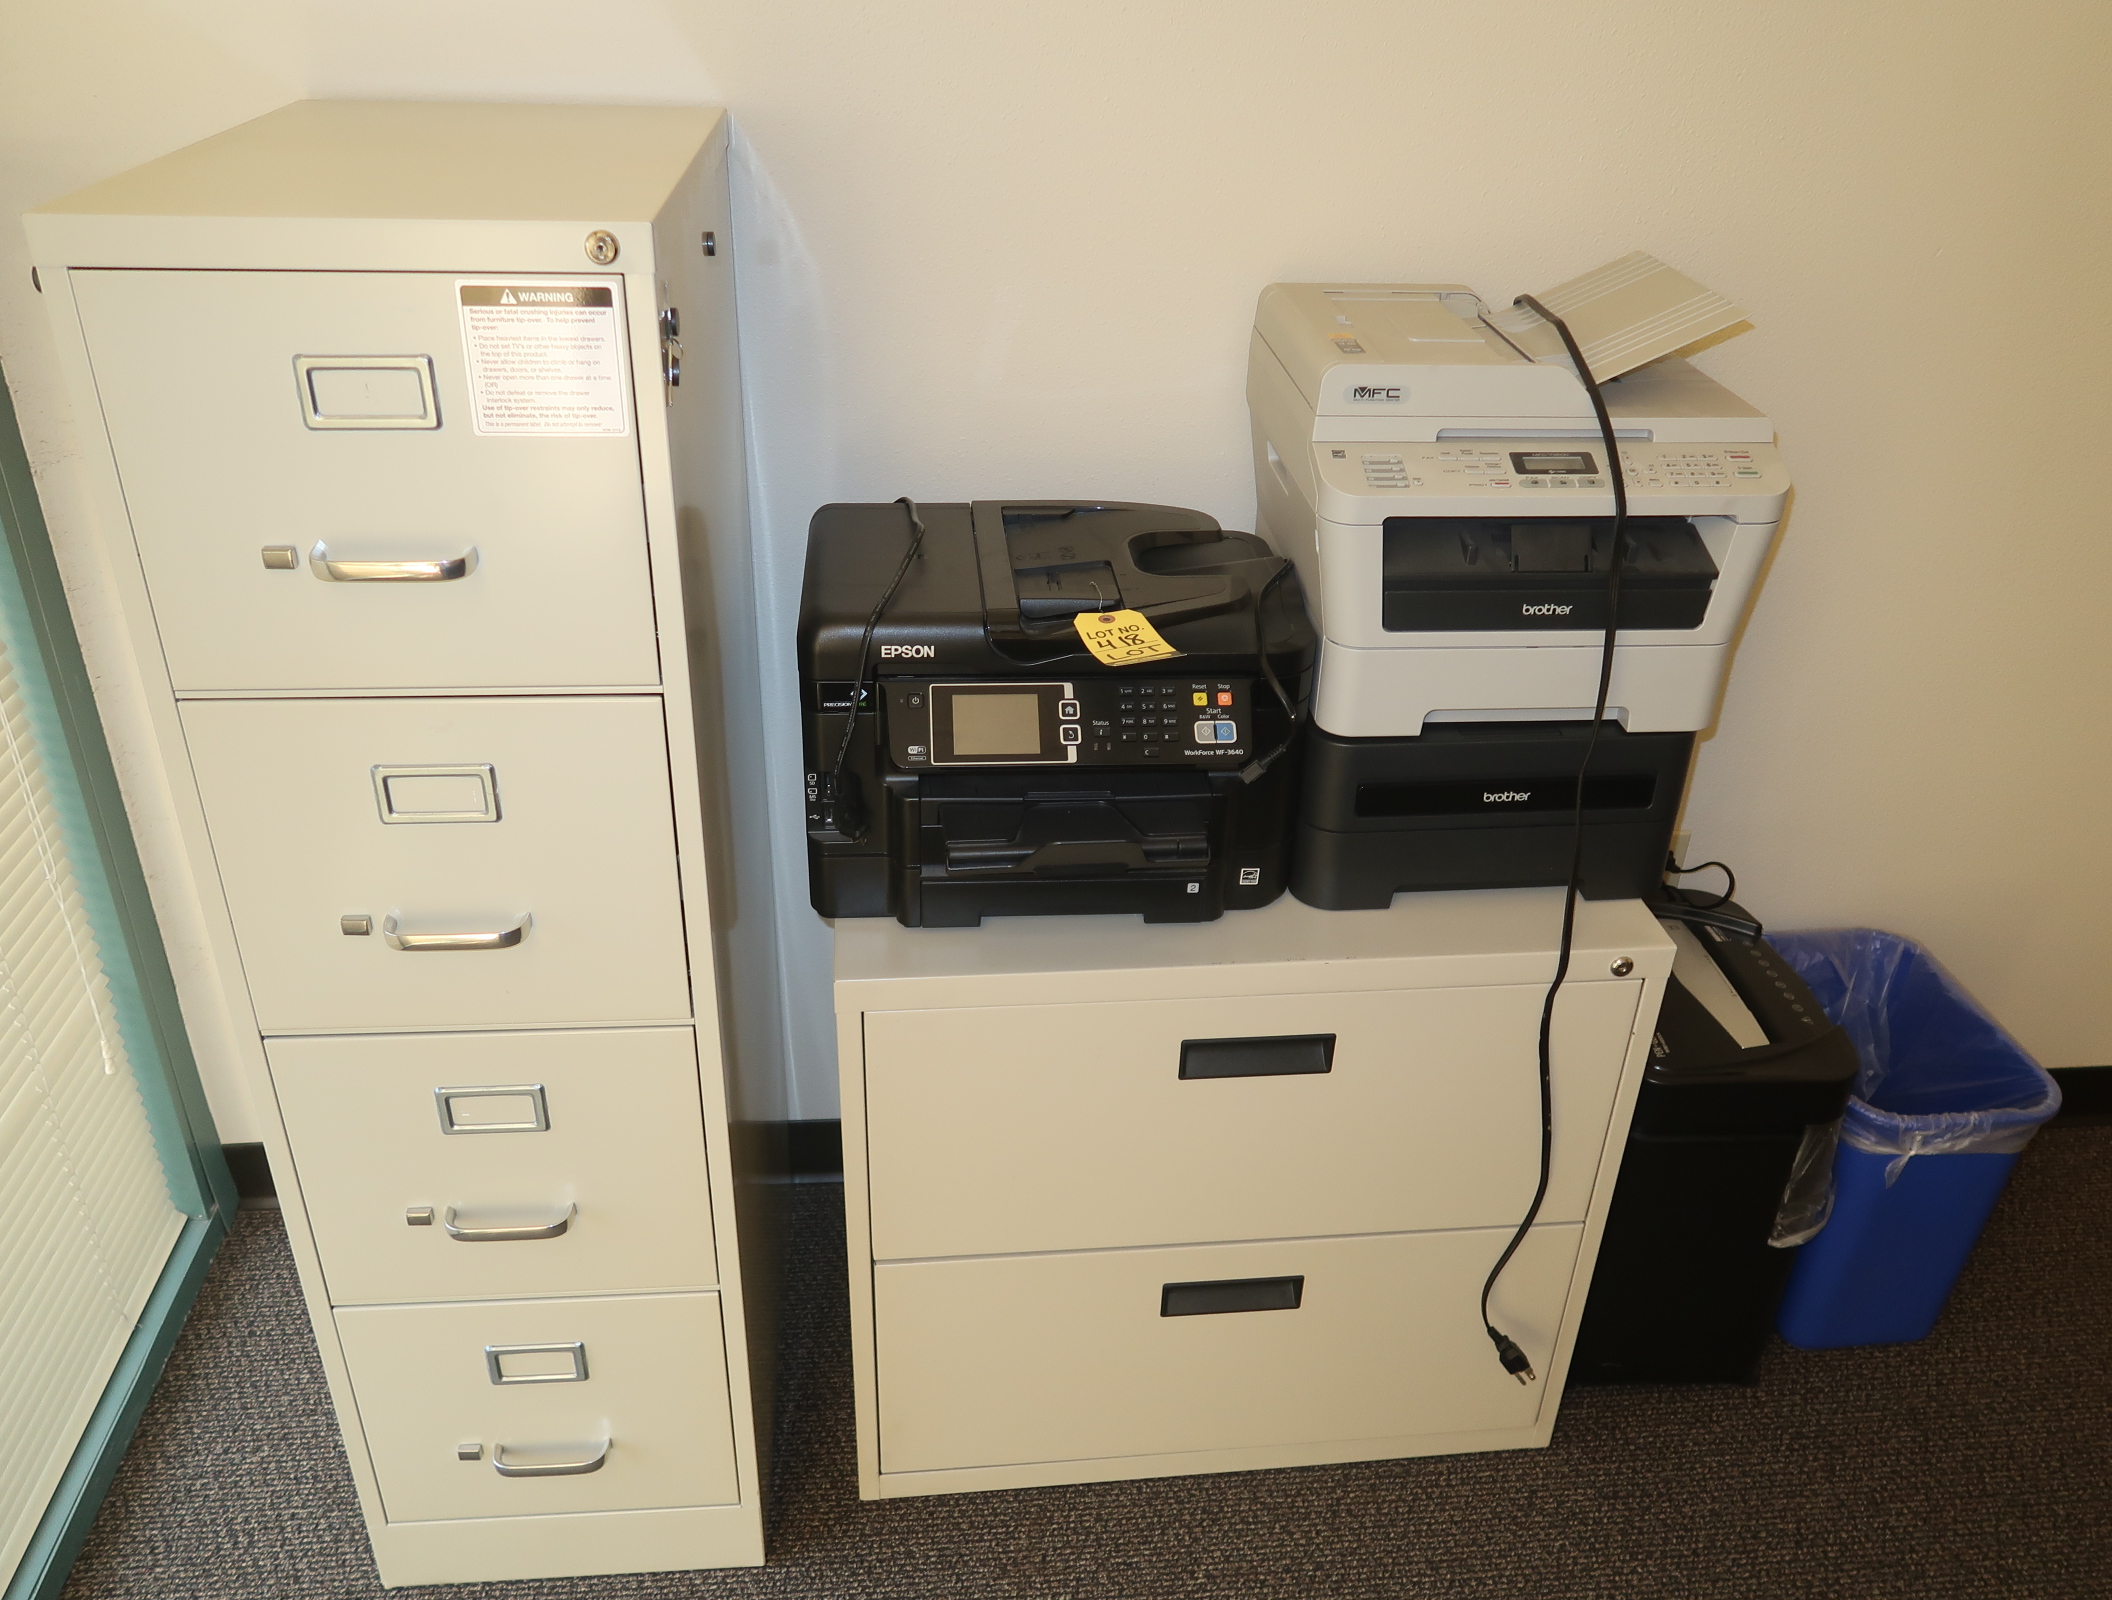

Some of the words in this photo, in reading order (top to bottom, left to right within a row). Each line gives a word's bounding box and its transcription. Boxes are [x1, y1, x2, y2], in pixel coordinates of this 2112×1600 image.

[518, 292, 574, 302] WARNING
[1354, 386, 1401, 398] MFC
[1522, 604, 1572, 615] brother
[1086, 629, 1114, 640] LOT
[1118, 624, 1144, 634] NO.
[1097, 634, 1144, 649] 418
[881, 645, 935, 658] EPSON
[1107, 644, 1161, 660] LOT
[1483, 792, 1530, 802] brother
